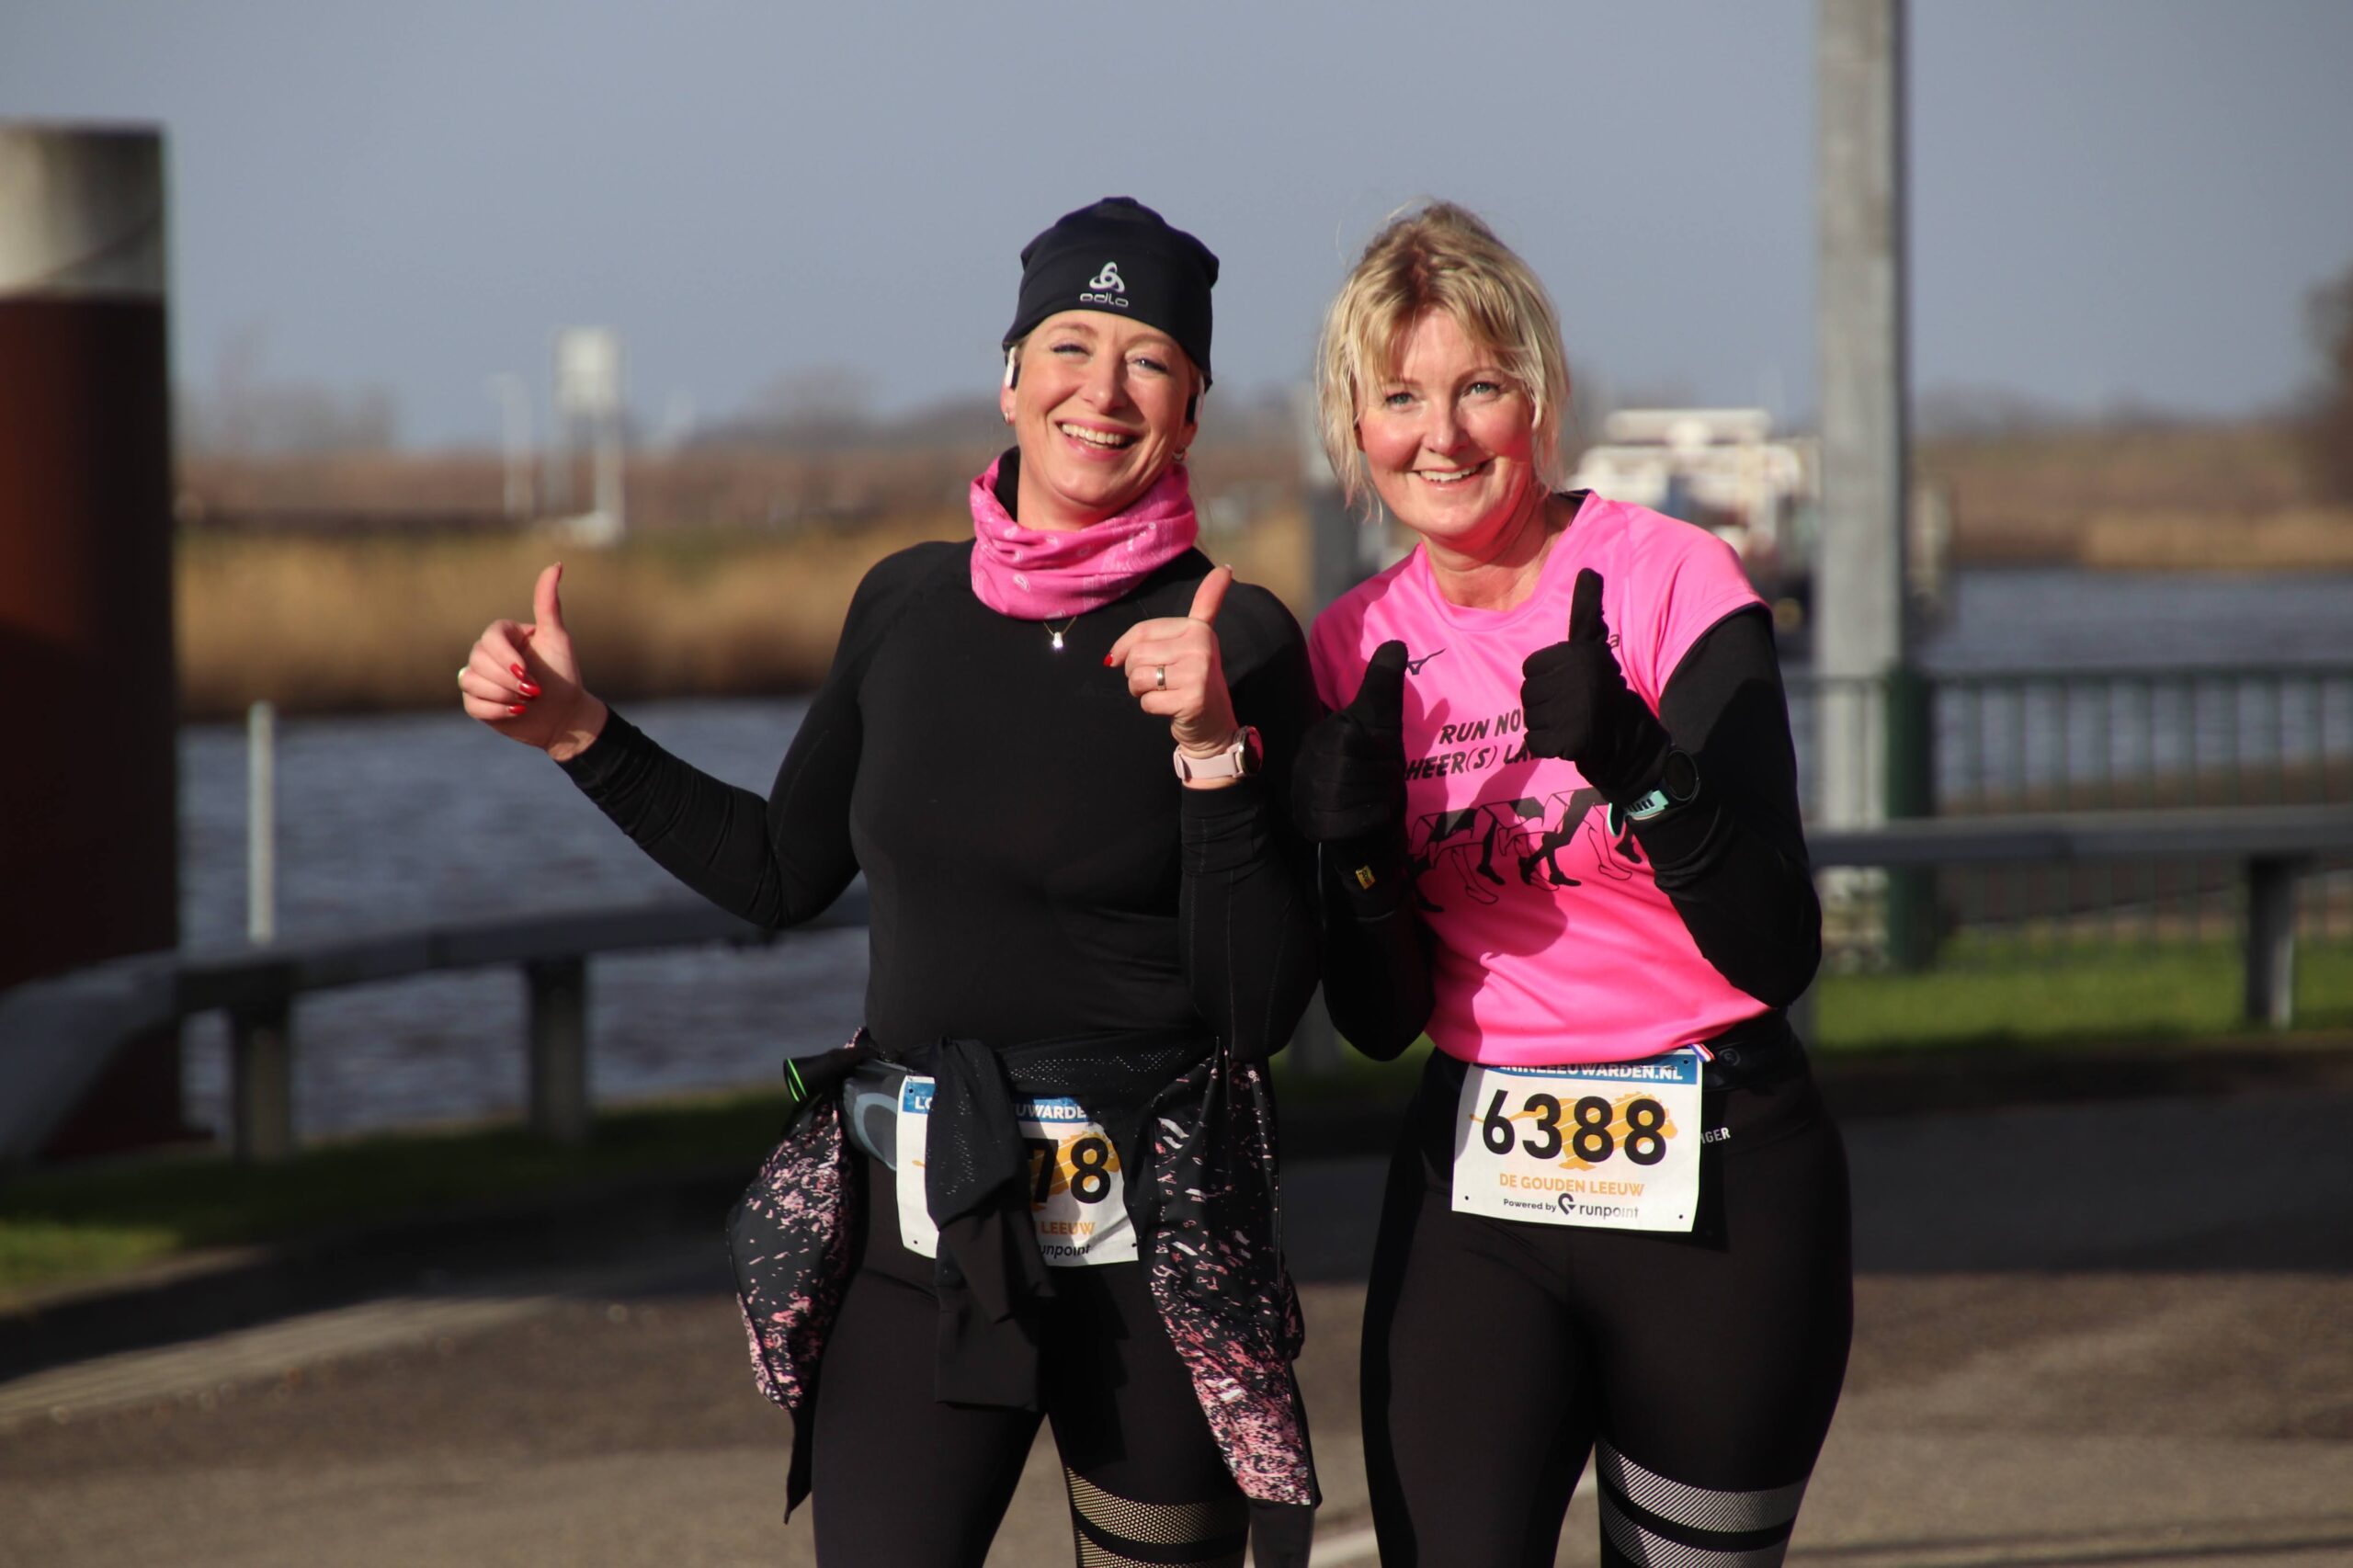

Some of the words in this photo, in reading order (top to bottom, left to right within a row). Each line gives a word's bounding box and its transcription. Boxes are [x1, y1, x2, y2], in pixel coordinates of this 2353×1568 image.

[1079, 292, 1129, 308] odlo
[1438, 718, 1491, 745] RUN
[1495, 707, 1524, 737] NO
[1405, 744, 1498, 781] HEER(S)
[1503, 743, 1537, 765] LA
[1014, 1103, 1086, 1119] UWARDE
[1483, 1088, 1666, 1165] 6388
[1024, 1137, 1111, 1204] 78
[1499, 1173, 1517, 1187] DE
[1520, 1176, 1586, 1193] GOUDEN
[1589, 1180, 1644, 1197] LEEUW
[1503, 1198, 1543, 1210] Powered
[1545, 1202, 1557, 1213] by
[1579, 1203, 1639, 1221] runpoint
[1040, 1221, 1096, 1235] LEEUW
